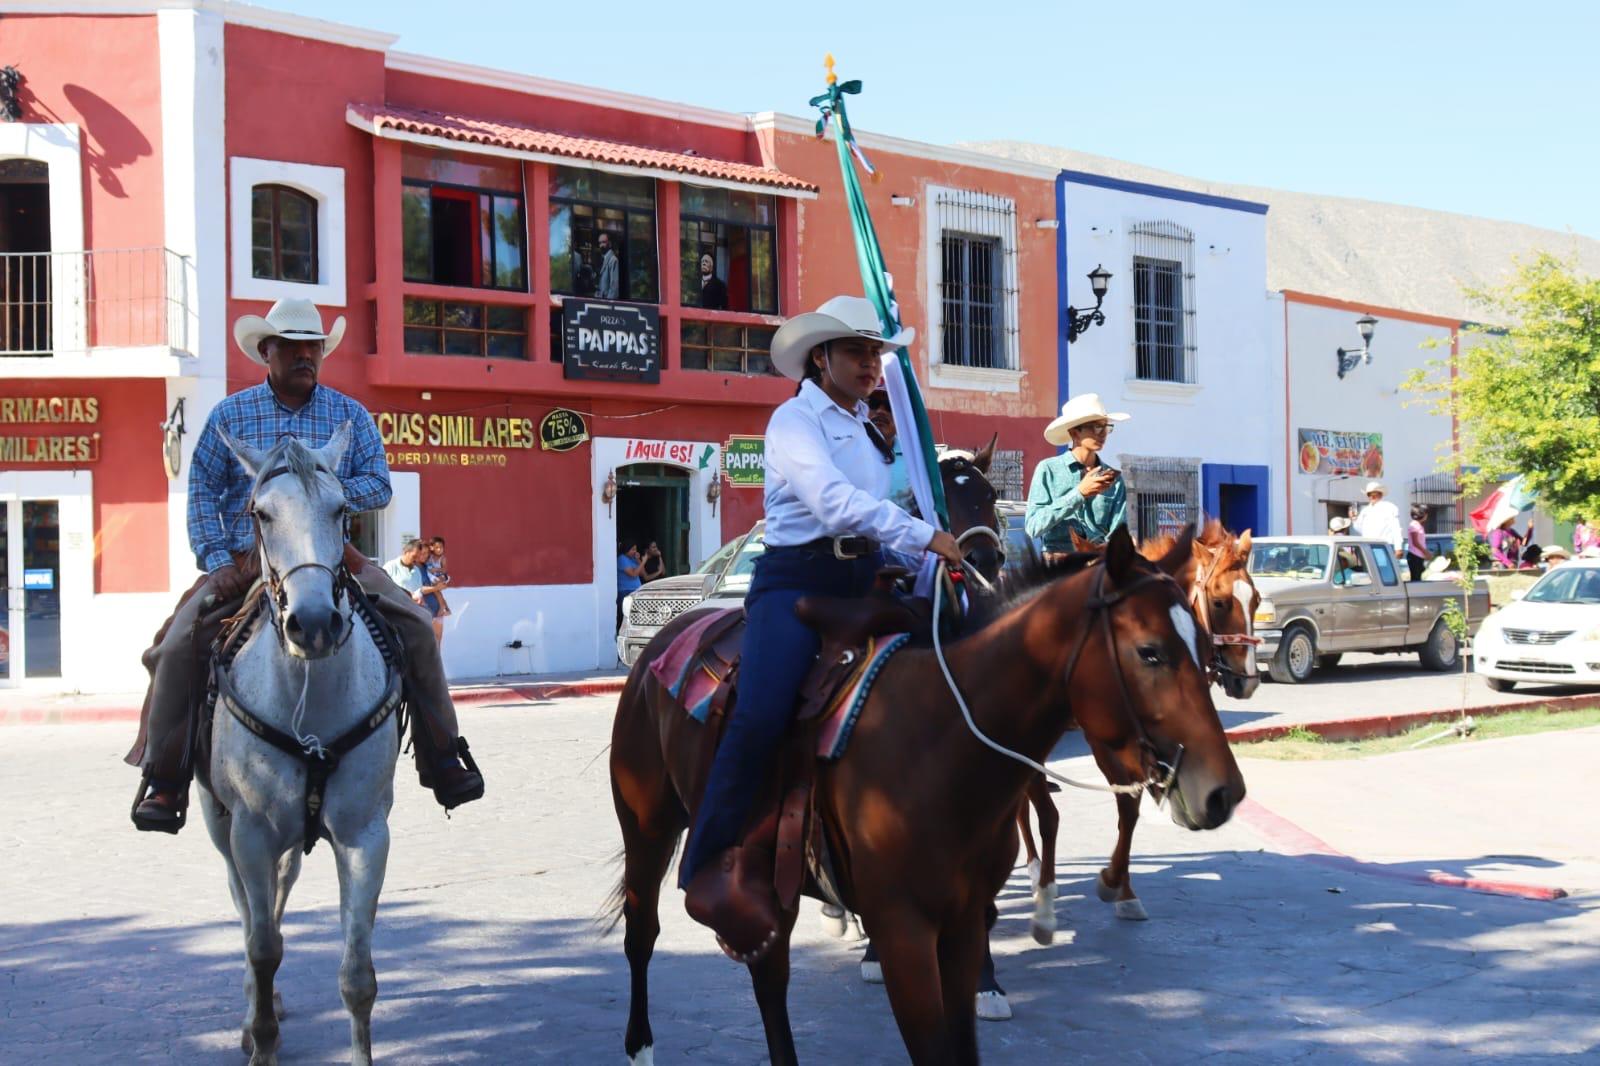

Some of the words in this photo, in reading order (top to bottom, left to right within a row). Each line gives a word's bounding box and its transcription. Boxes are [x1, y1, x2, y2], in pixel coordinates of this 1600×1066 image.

[578, 327, 649, 355] PAPPAS
[0, 397, 98, 423] RMACIAS
[428, 414, 533, 448] SIMILARES
[548, 416, 578, 438] 75%
[397, 452, 430, 465] PERO
[460, 453, 506, 466] BARATO
[625, 440, 667, 461] ¡Aquí
[670, 444, 694, 463] es!
[725, 453, 765, 469] PAPPA
